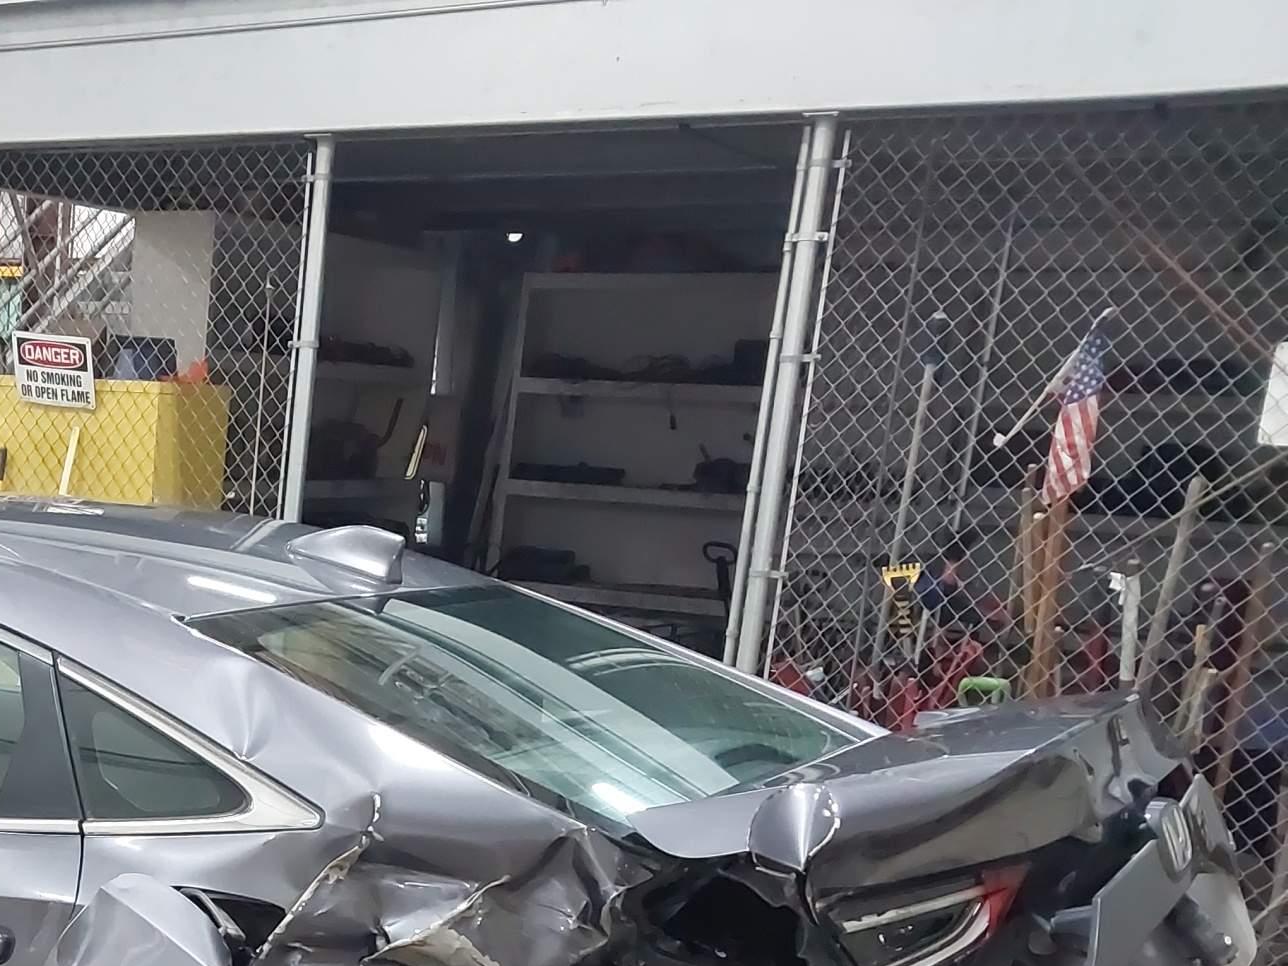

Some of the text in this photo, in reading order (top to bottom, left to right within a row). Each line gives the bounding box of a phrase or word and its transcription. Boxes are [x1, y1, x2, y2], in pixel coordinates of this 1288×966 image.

[24, 344, 80, 365] DANGER
[26, 369, 83, 388] NO SMOKING
[21, 384, 91, 405] OR OPEN FLAME
